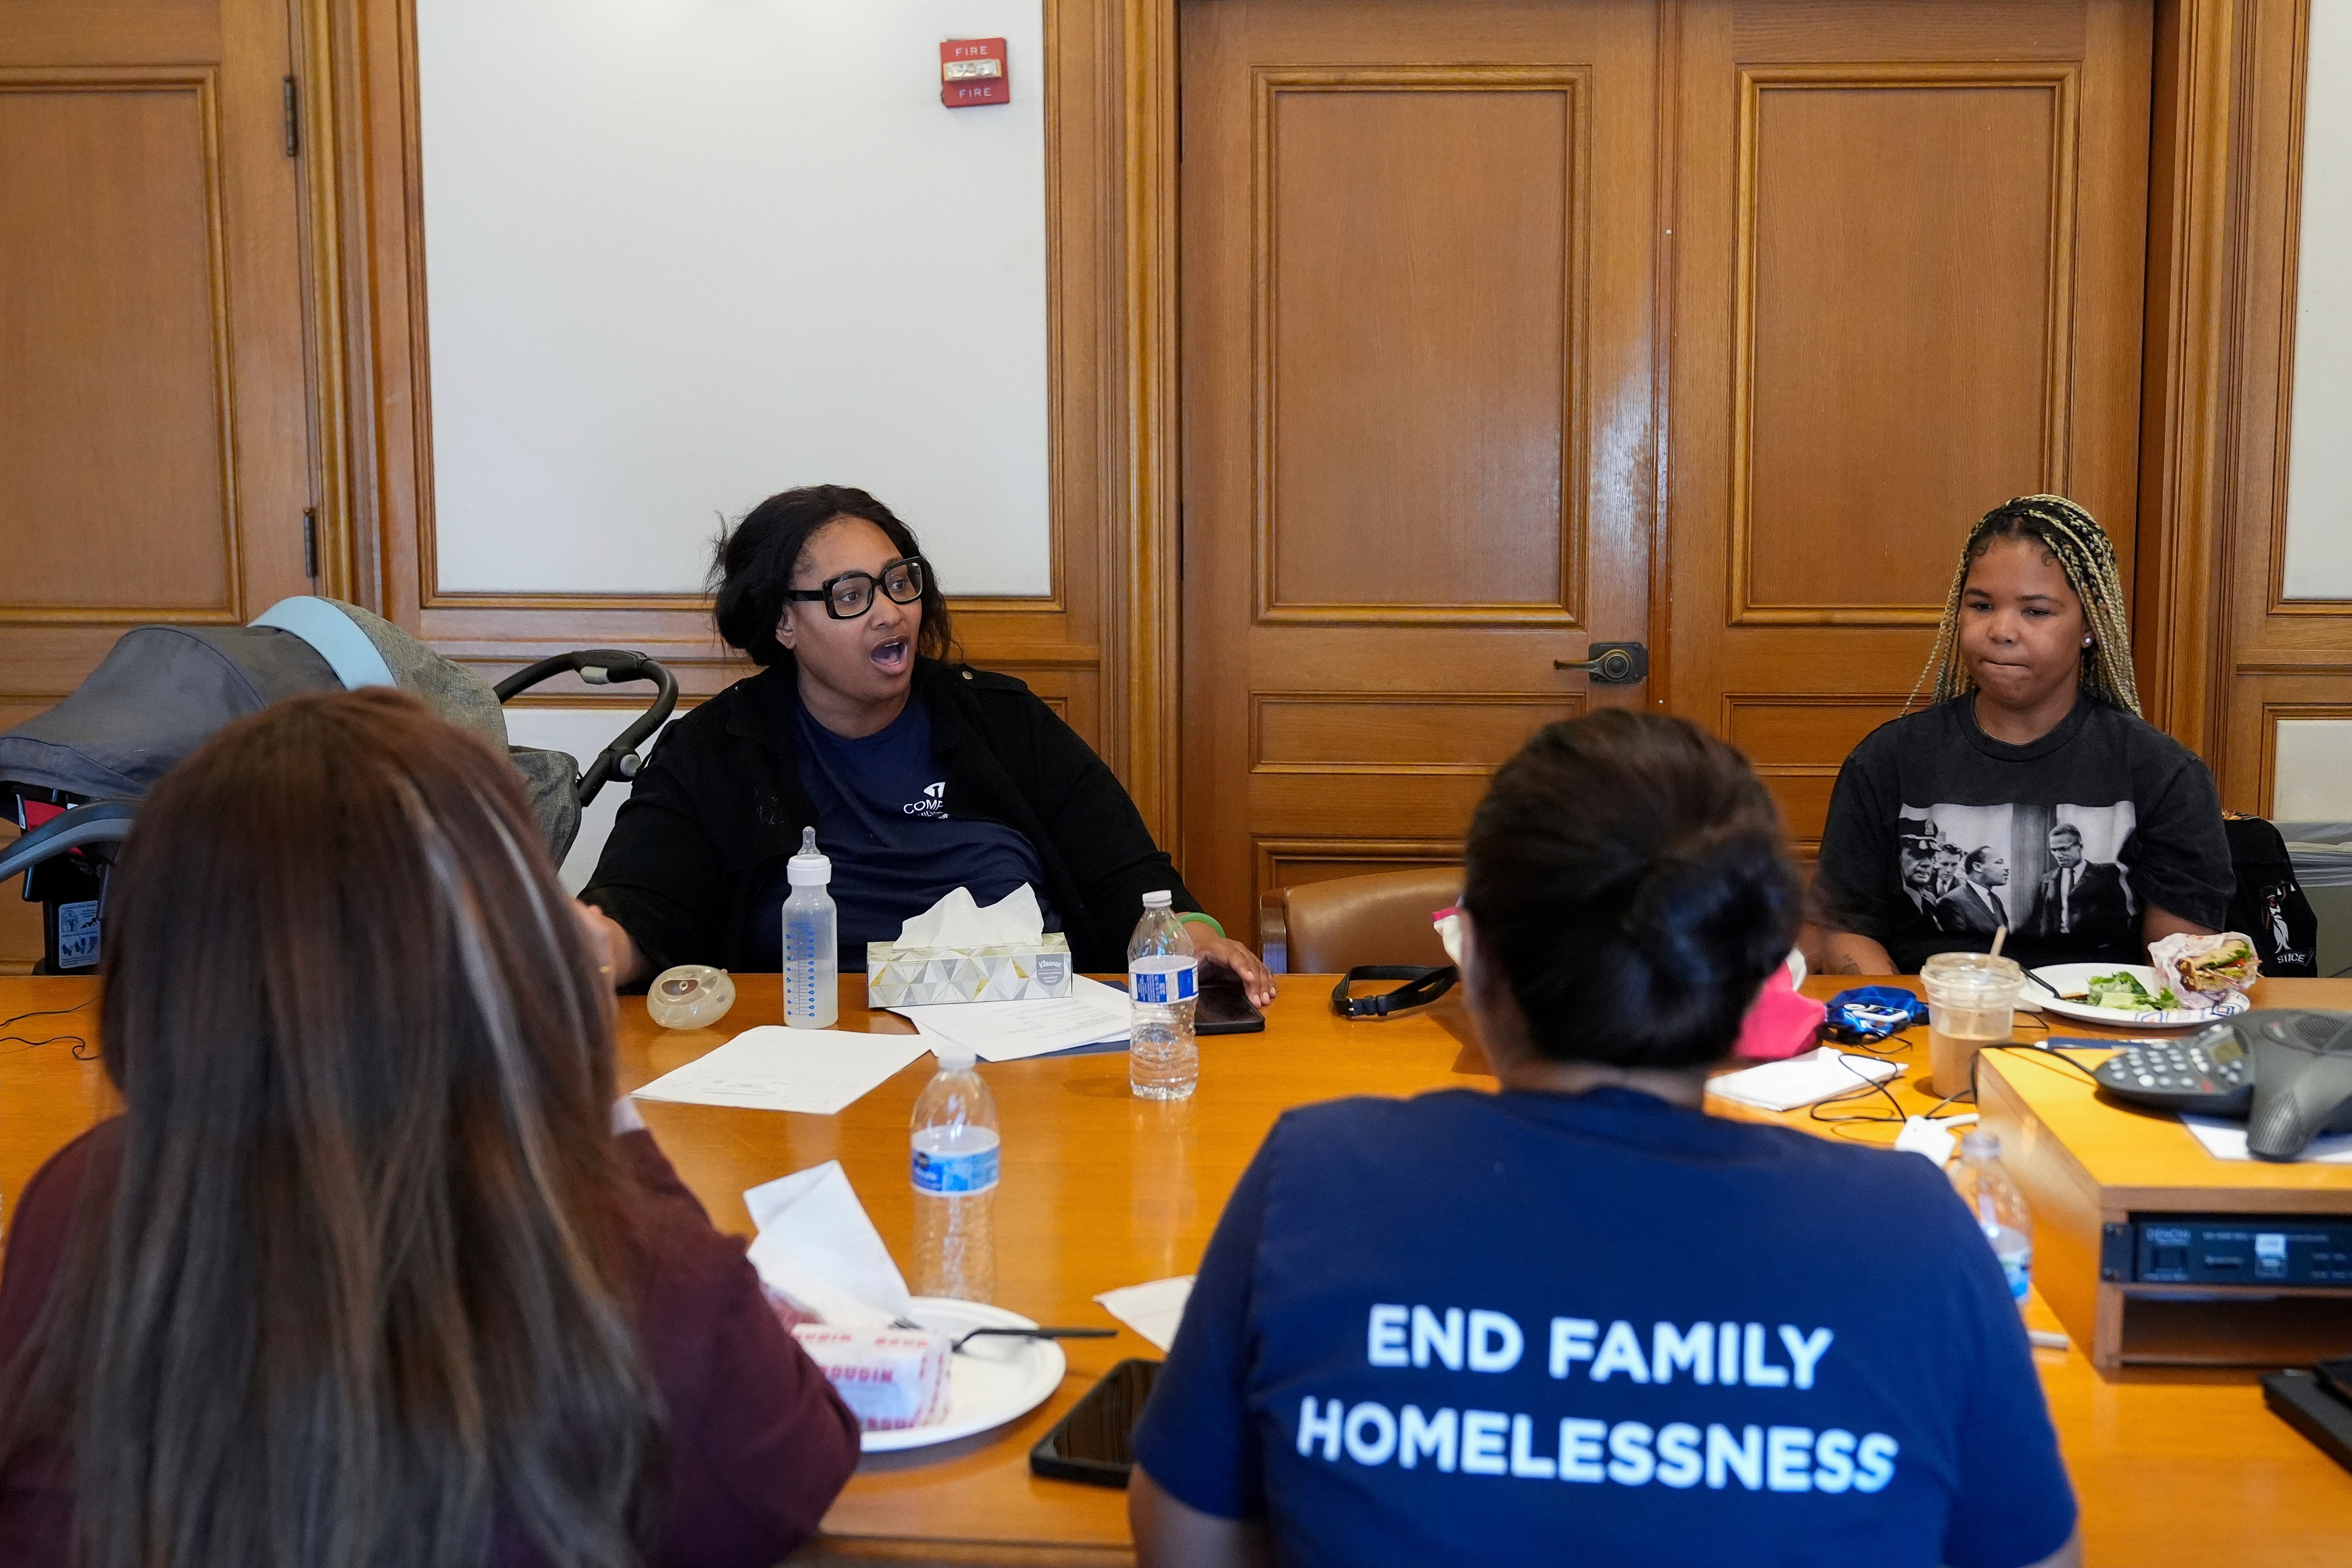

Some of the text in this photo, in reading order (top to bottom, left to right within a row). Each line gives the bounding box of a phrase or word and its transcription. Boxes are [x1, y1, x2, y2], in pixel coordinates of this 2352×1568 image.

[955, 45, 988, 56] FIRE
[959, 87, 992, 98] FIRE
[1038, 960, 1061, 969] Kleenex
[1367, 1304, 1833, 1389] END FAMILY
[1297, 1396, 1898, 1492] HOMELESSNESS
